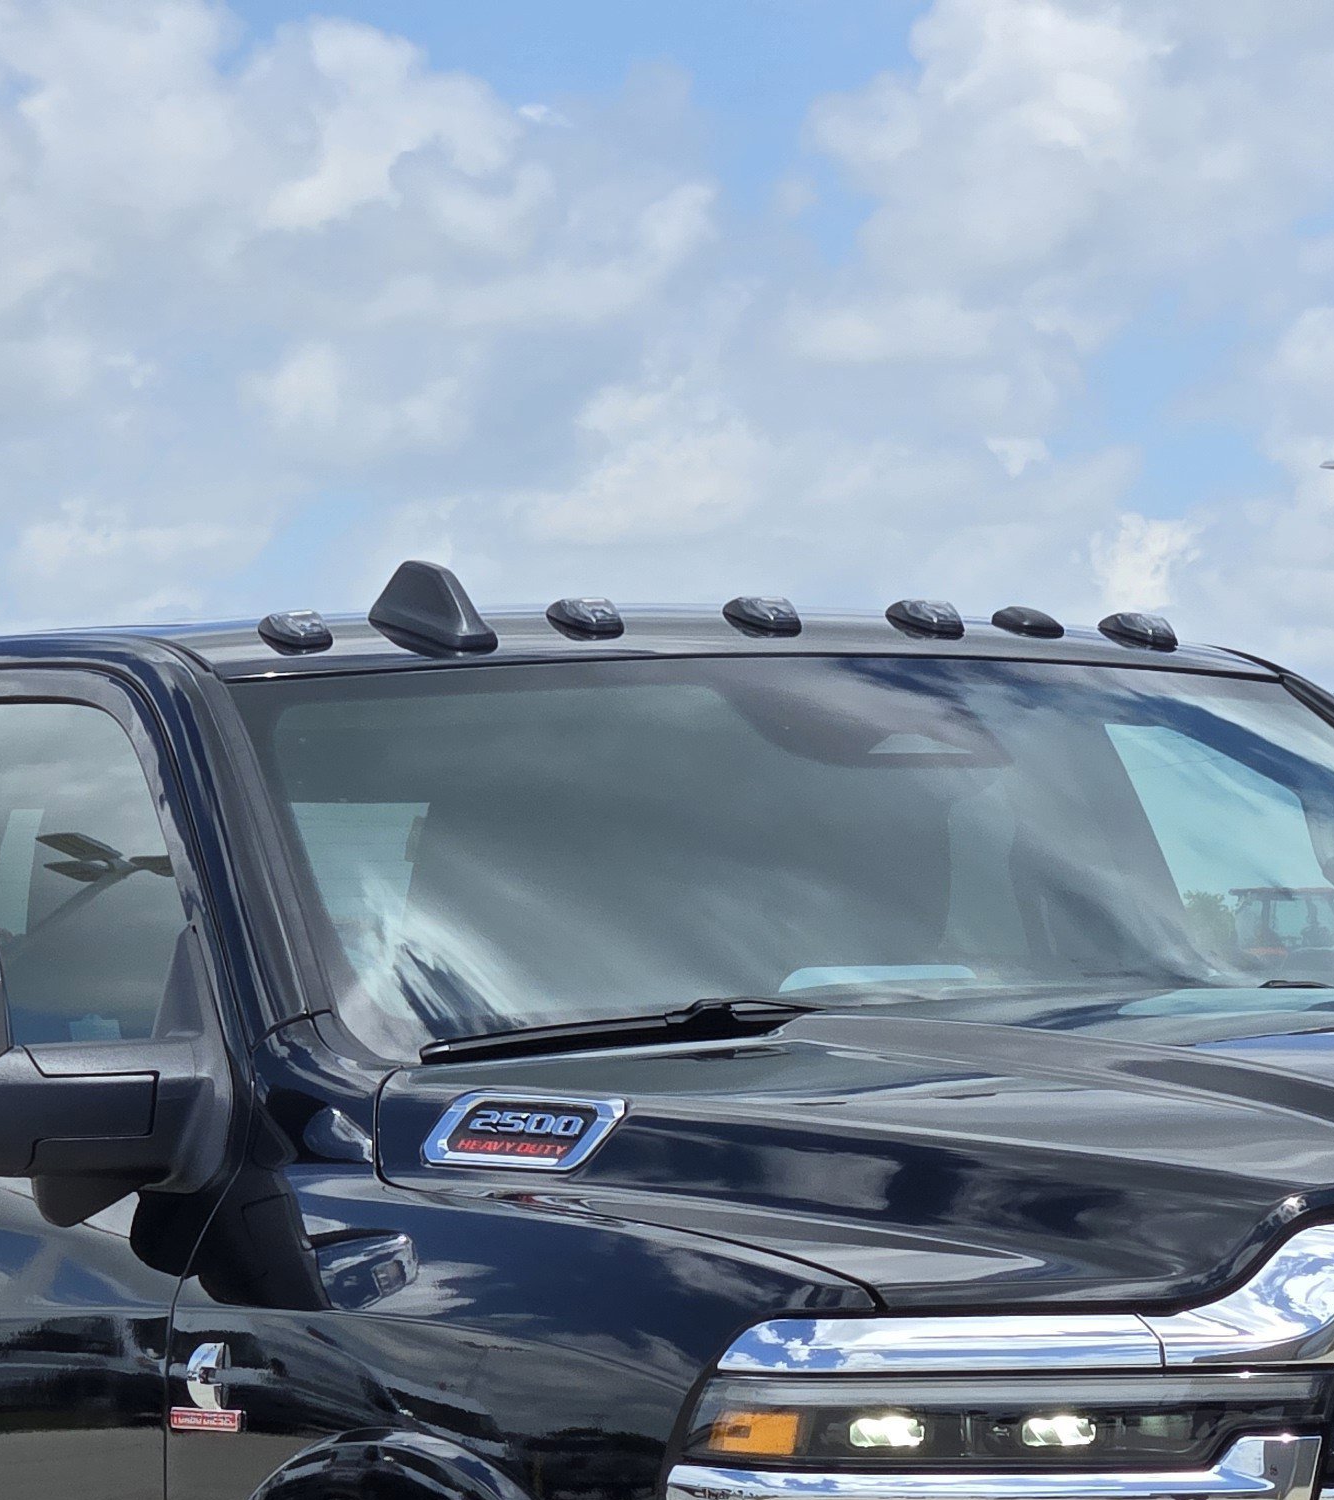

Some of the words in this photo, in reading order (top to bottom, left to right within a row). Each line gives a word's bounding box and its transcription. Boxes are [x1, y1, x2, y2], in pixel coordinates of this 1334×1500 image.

[469, 1110, 584, 1137] 2500
[456, 1138, 516, 1153] HEAVY
[517, 1141, 567, 1156] DUTY
